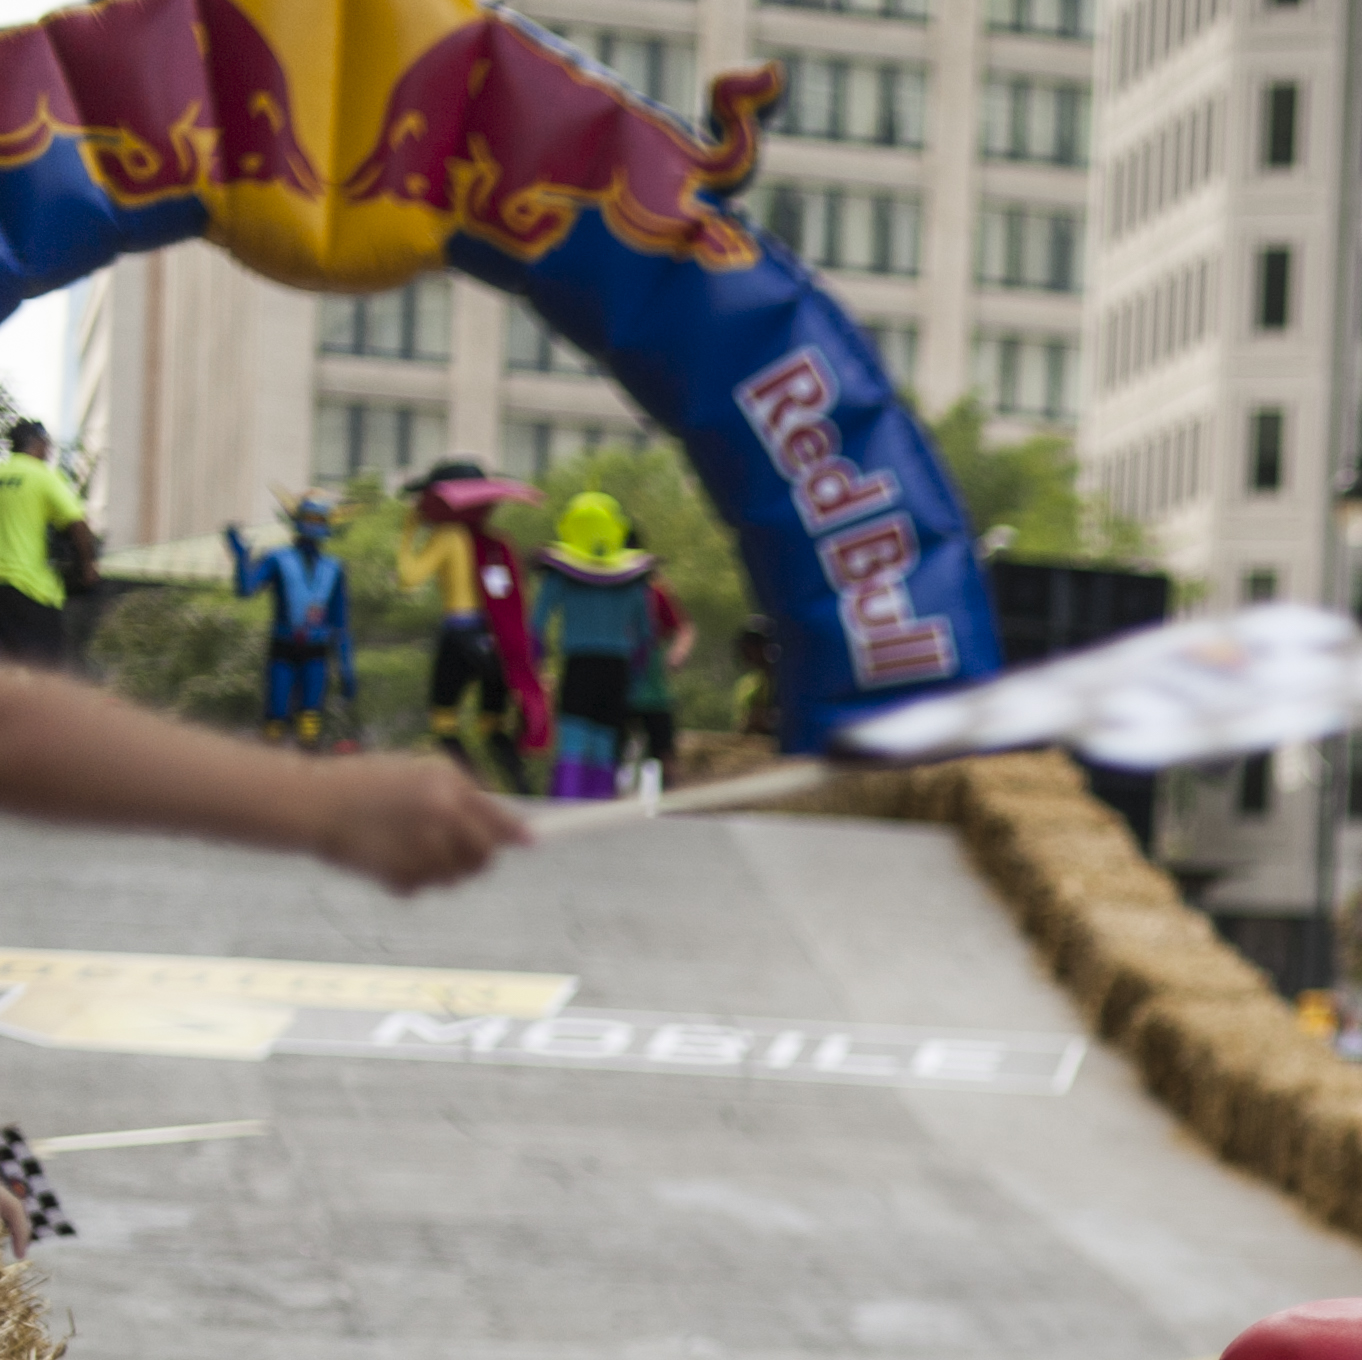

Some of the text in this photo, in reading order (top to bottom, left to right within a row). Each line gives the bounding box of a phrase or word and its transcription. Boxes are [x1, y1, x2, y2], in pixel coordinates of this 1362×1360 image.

[735, 347, 958, 690] Red Bull
[371, 1010, 1004, 1081] MOBILE
